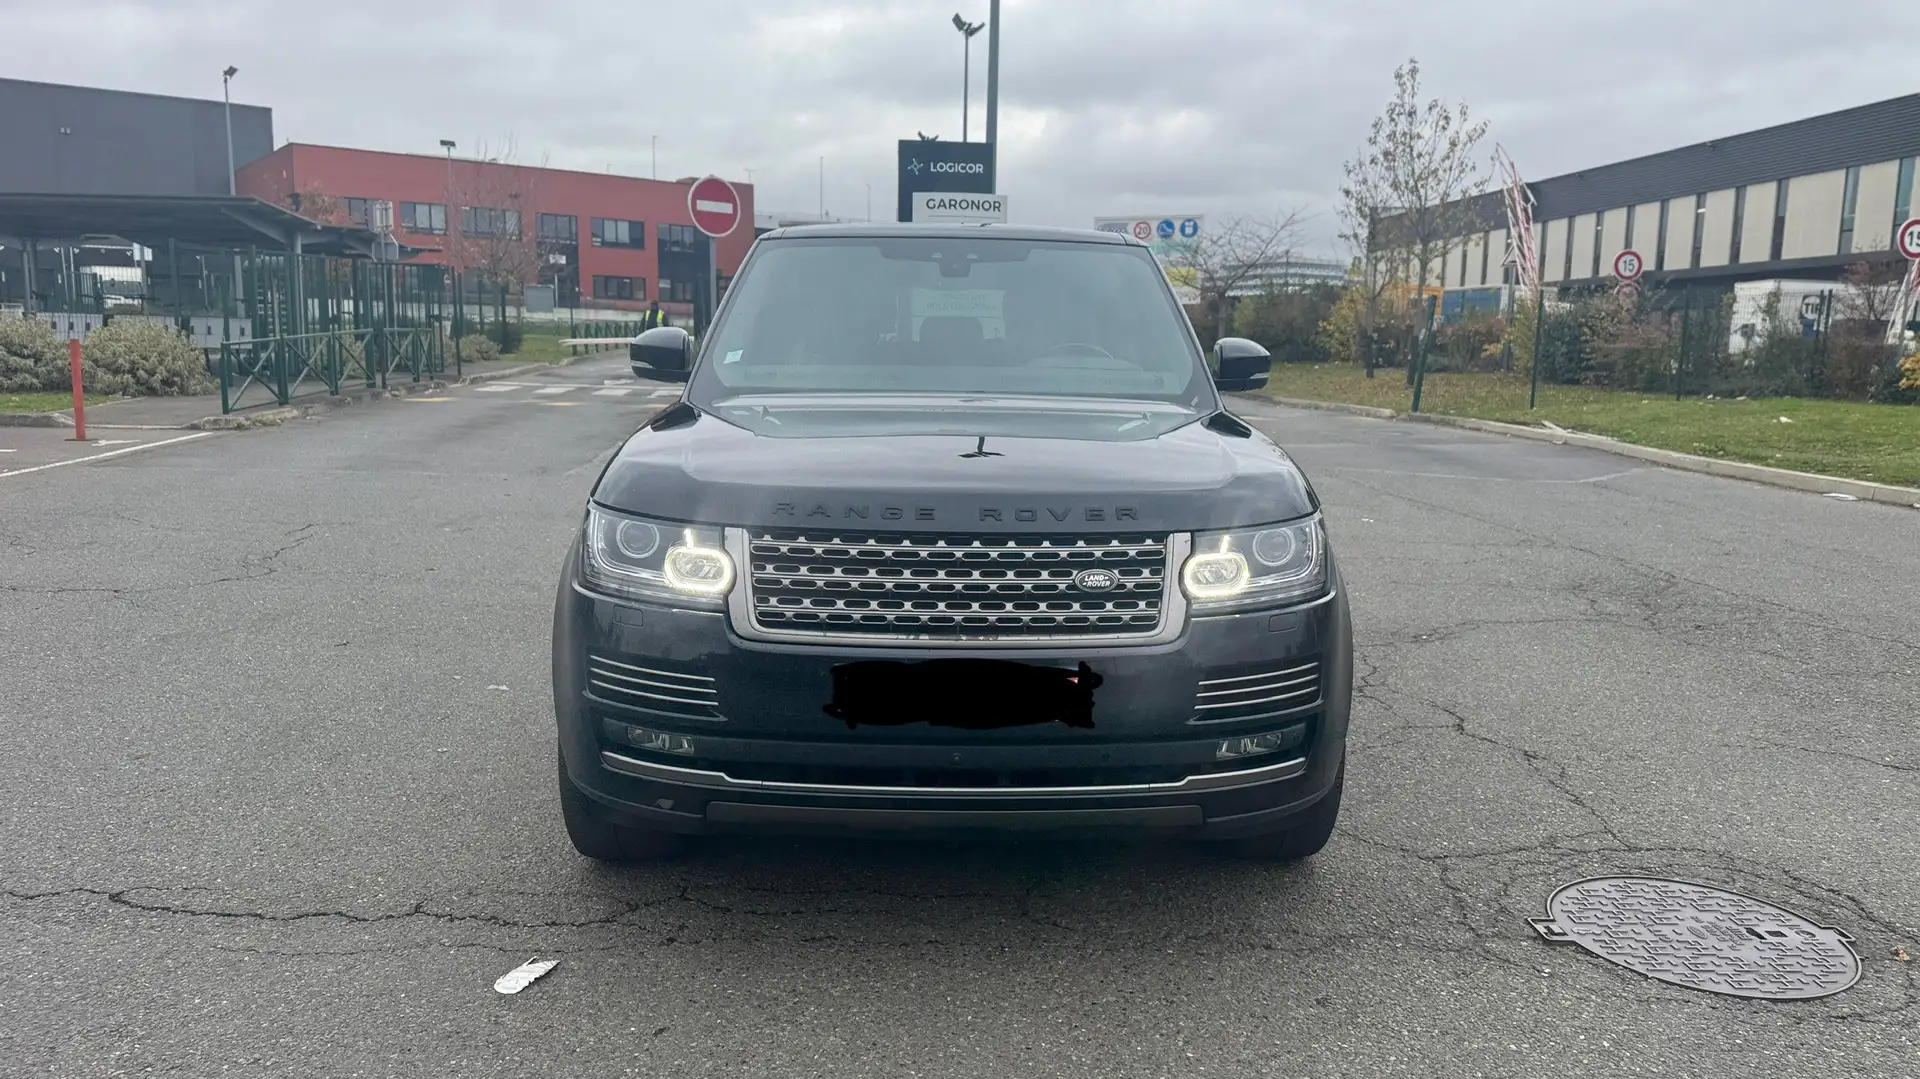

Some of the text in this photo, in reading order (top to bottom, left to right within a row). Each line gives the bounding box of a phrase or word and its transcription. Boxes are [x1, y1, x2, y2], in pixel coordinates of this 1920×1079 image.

[930, 162, 984, 174] LOGICOR
[926, 198, 1002, 212] GARONOR
[1138, 227, 1148, 235] 20
[1623, 259, 1635, 272] 15
[771, 502, 1140, 522] RANGE ROVER
